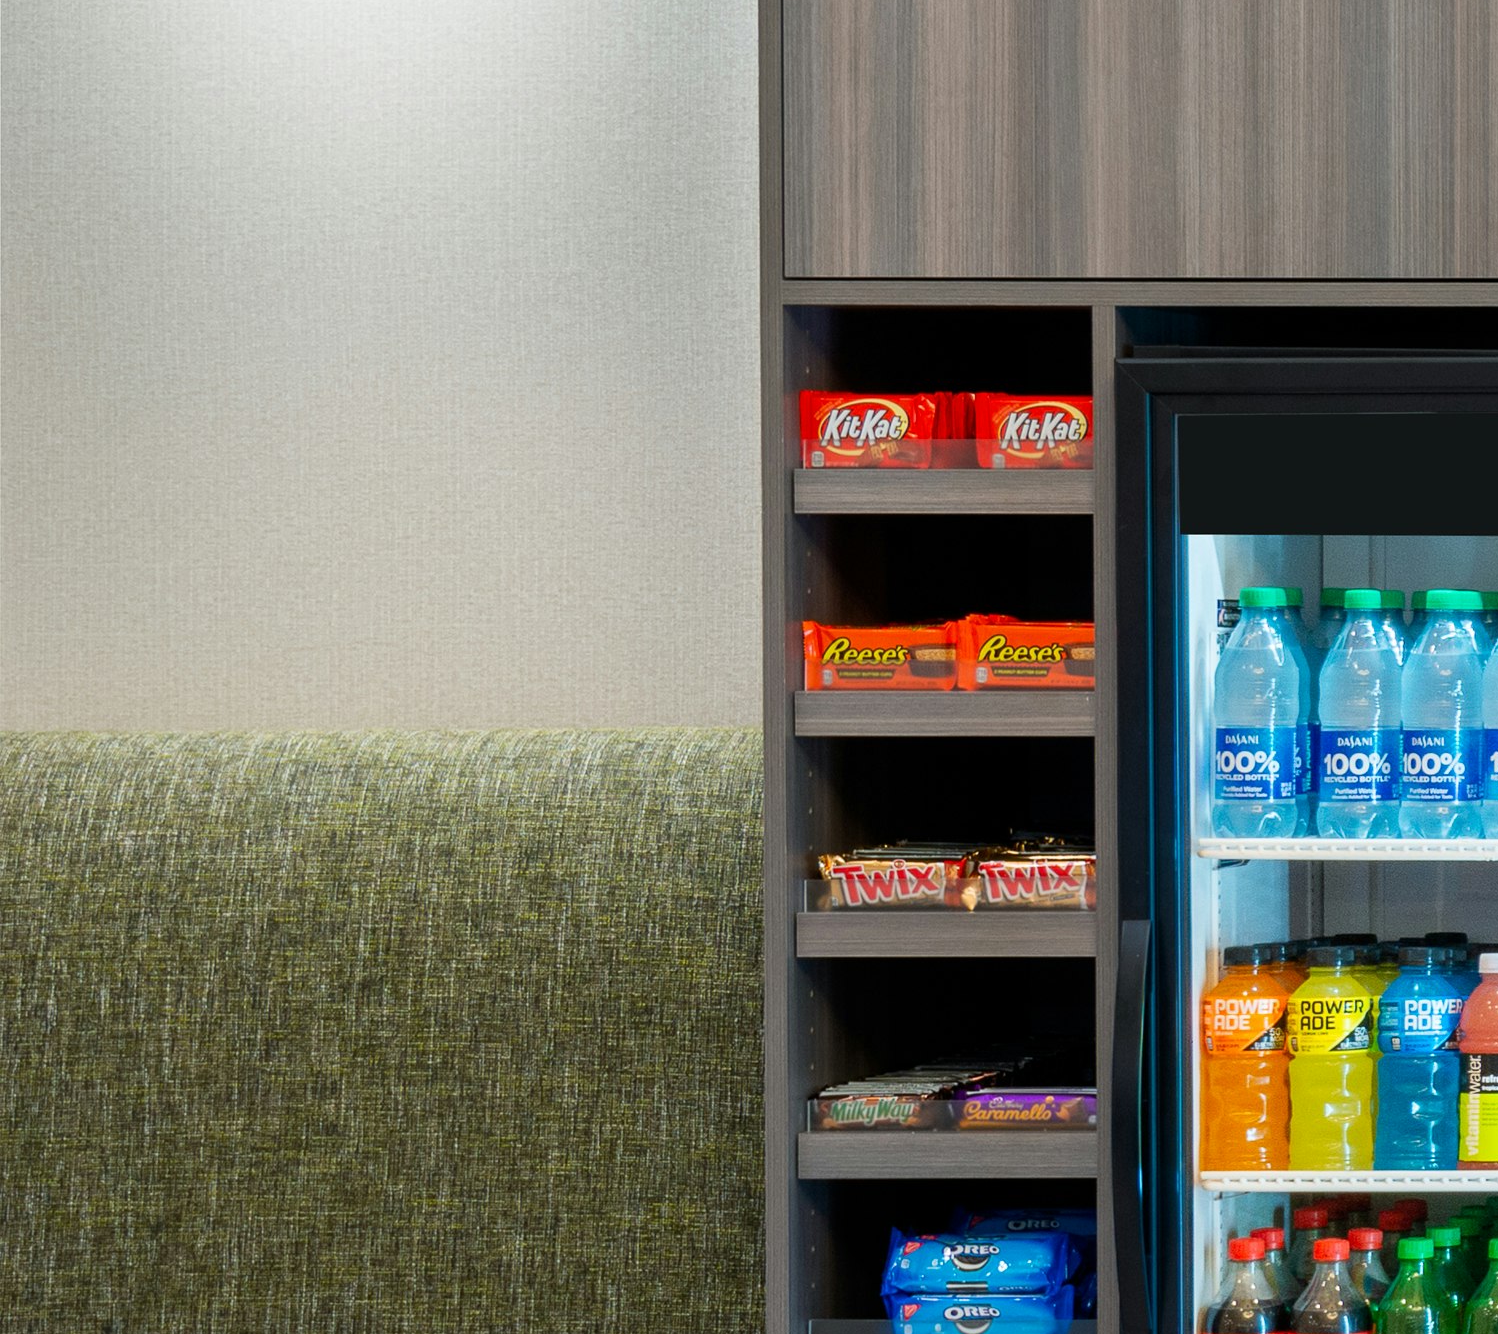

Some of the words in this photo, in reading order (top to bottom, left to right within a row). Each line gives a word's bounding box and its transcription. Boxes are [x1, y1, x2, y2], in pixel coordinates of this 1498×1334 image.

[822, 637, 908, 665] Reese's
[978, 635, 1064, 662] Reese's
[1225, 734, 1259, 746] DASANI
[1323, 753, 1390, 776] 100%
[831, 859, 943, 906] Twix
[978, 859, 1082, 902] Twix
[1215, 998, 1281, 1015] POWER
[1300, 999, 1364, 1015] POWER
[1214, 1014, 1250, 1030] ADE
[1300, 1015, 1336, 1030] ADE
[944, 1244, 1000, 1257] OREO
[944, 1306, 1000, 1320] OREO
